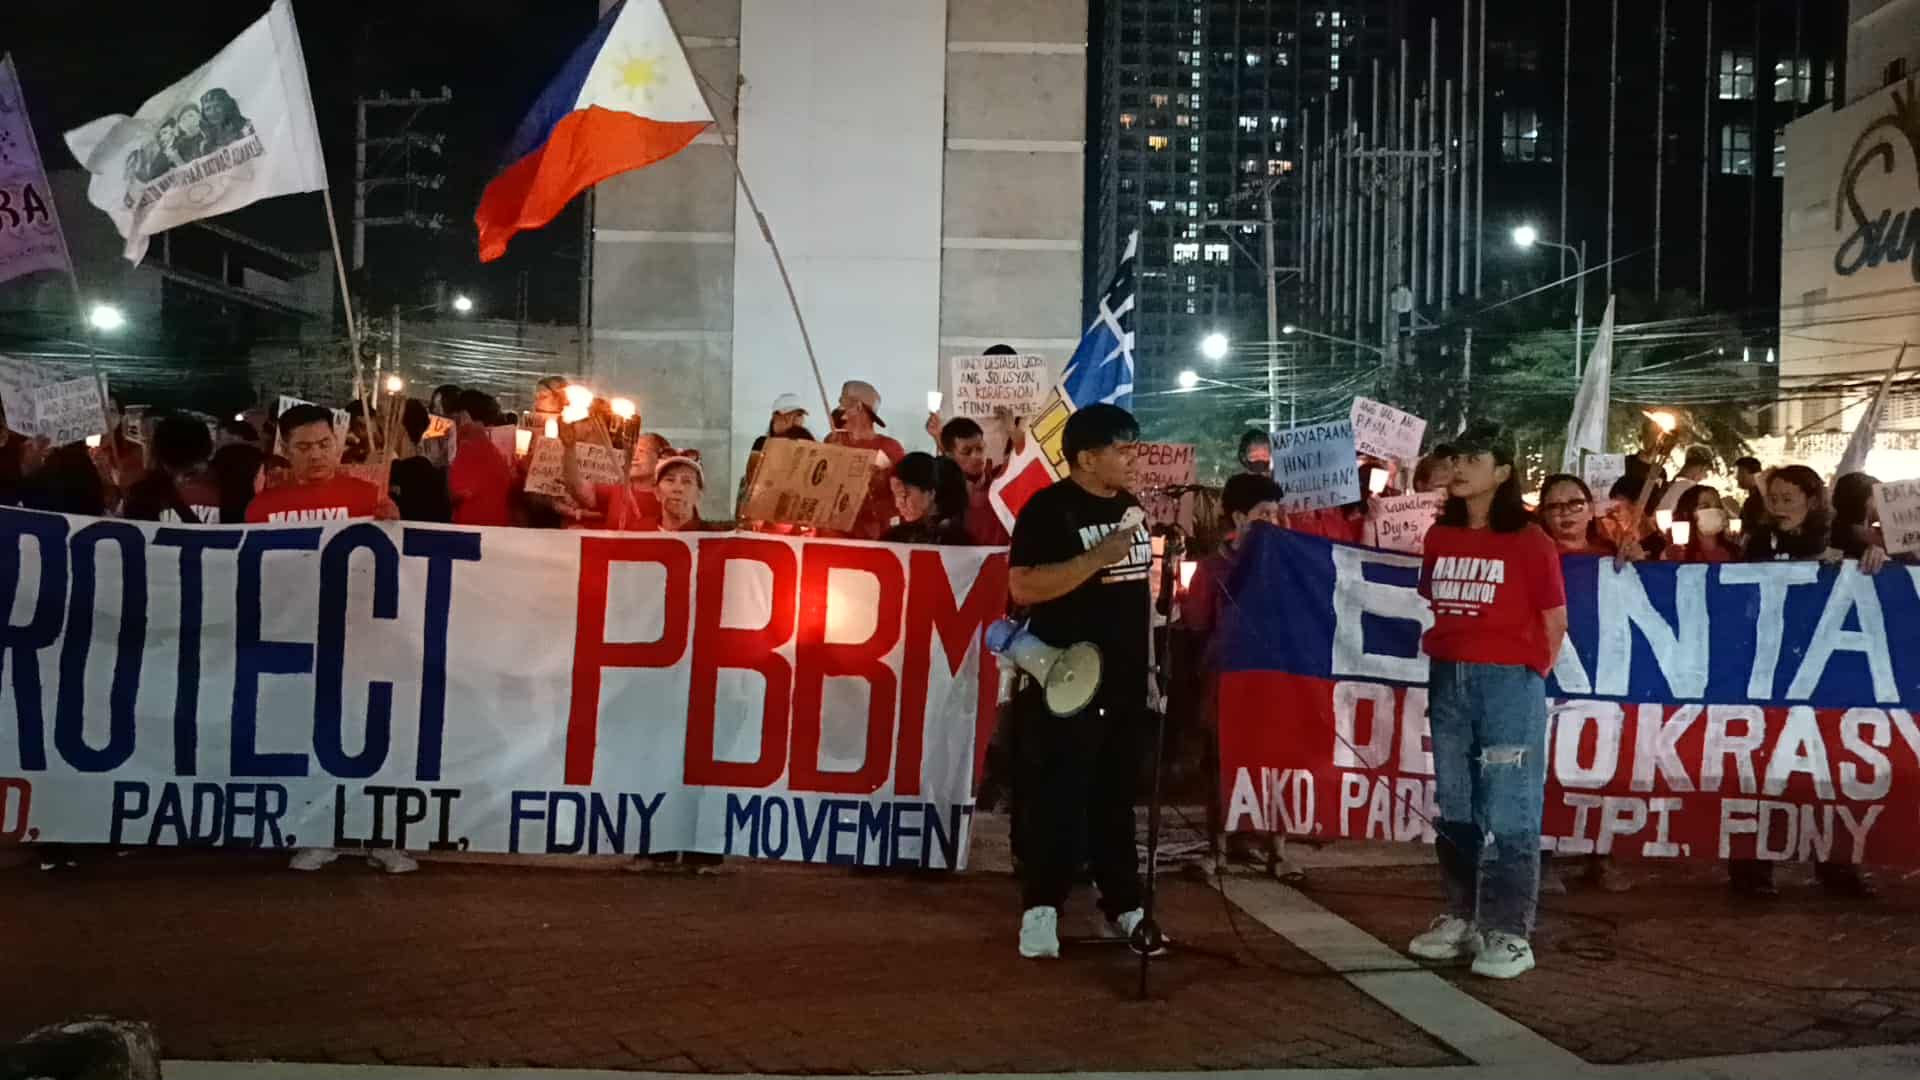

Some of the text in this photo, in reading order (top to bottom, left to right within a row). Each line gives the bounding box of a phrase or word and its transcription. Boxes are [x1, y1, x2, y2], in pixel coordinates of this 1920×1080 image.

[1136, 444, 1194, 465] PBBM!
[1331, 544, 1920, 704] BNTA
[564, 536, 1010, 797] PBBM
[509, 790, 666, 854] FDNY
[1718, 798, 1884, 866] FDNY
